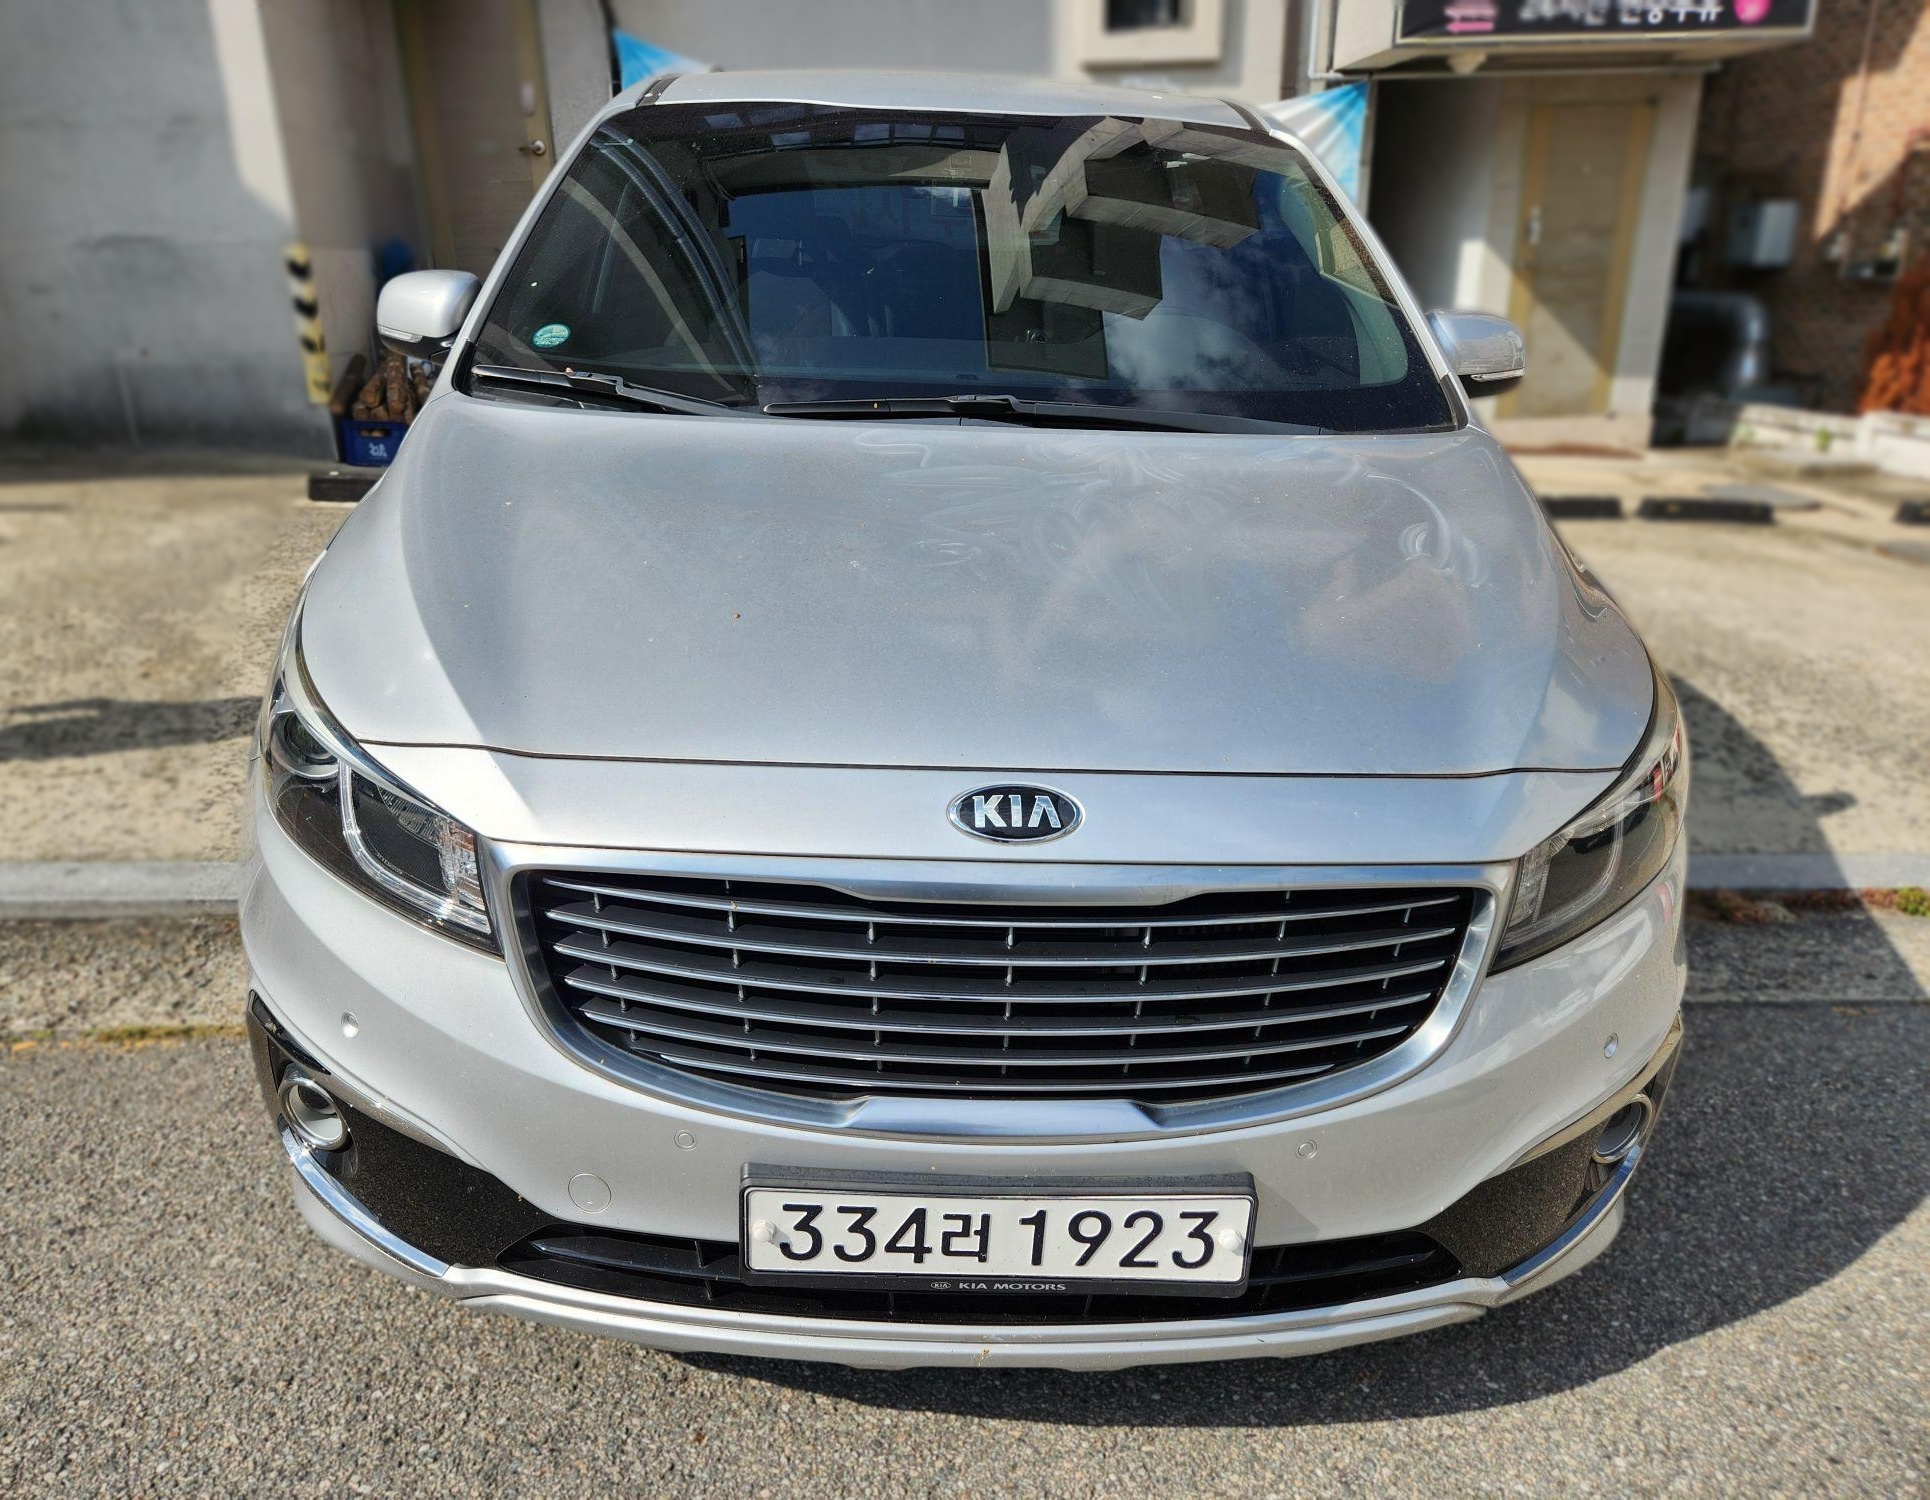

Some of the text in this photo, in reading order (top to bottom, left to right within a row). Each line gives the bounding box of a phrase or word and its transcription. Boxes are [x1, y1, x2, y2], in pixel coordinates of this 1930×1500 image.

[972, 794, 1062, 829] KIA
[779, 1203, 1220, 1270] 334러 1923
[958, 1282, 1067, 1291] KIA MOTORS
